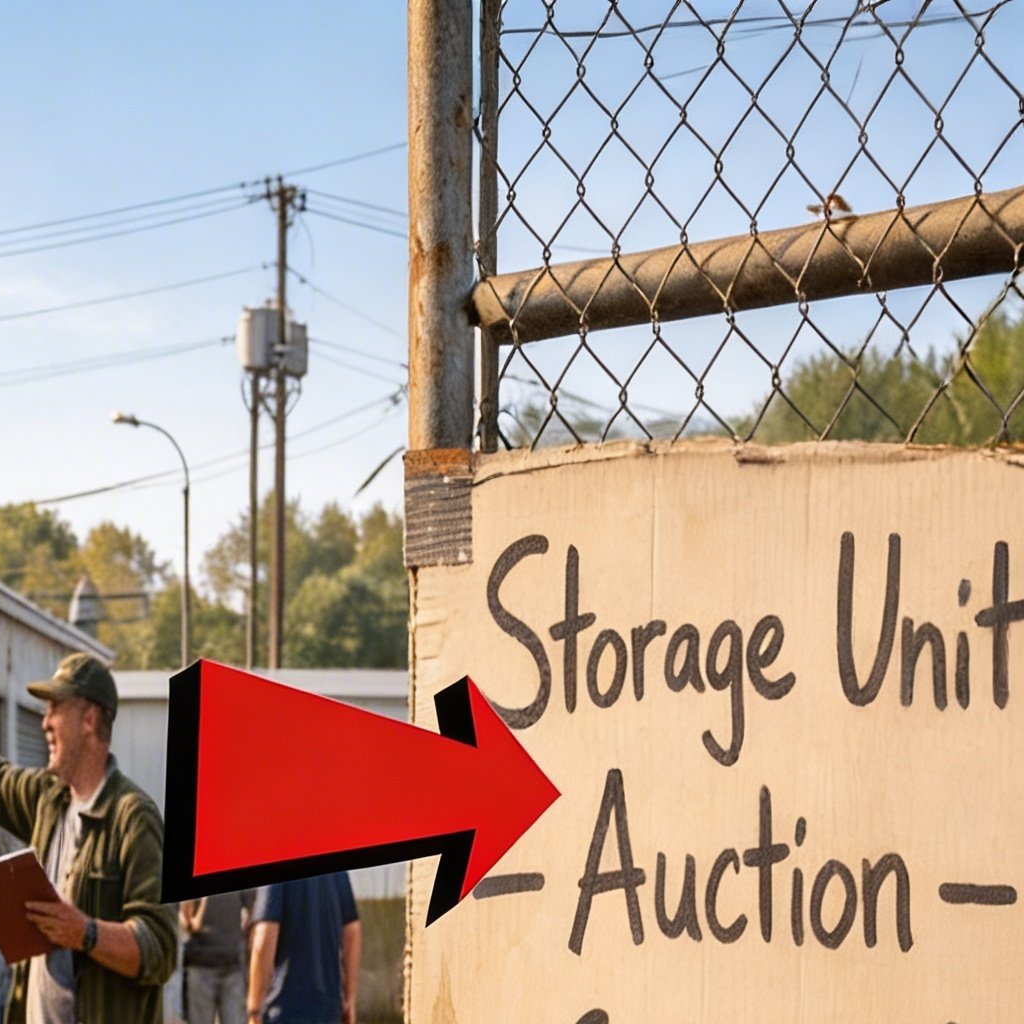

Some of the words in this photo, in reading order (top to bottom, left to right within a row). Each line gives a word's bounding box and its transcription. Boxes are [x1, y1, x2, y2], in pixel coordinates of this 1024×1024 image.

[486, 533, 796, 767] Storage
[836, 531, 1024, 712] Unit
[567, 768, 915, 956] Auction
